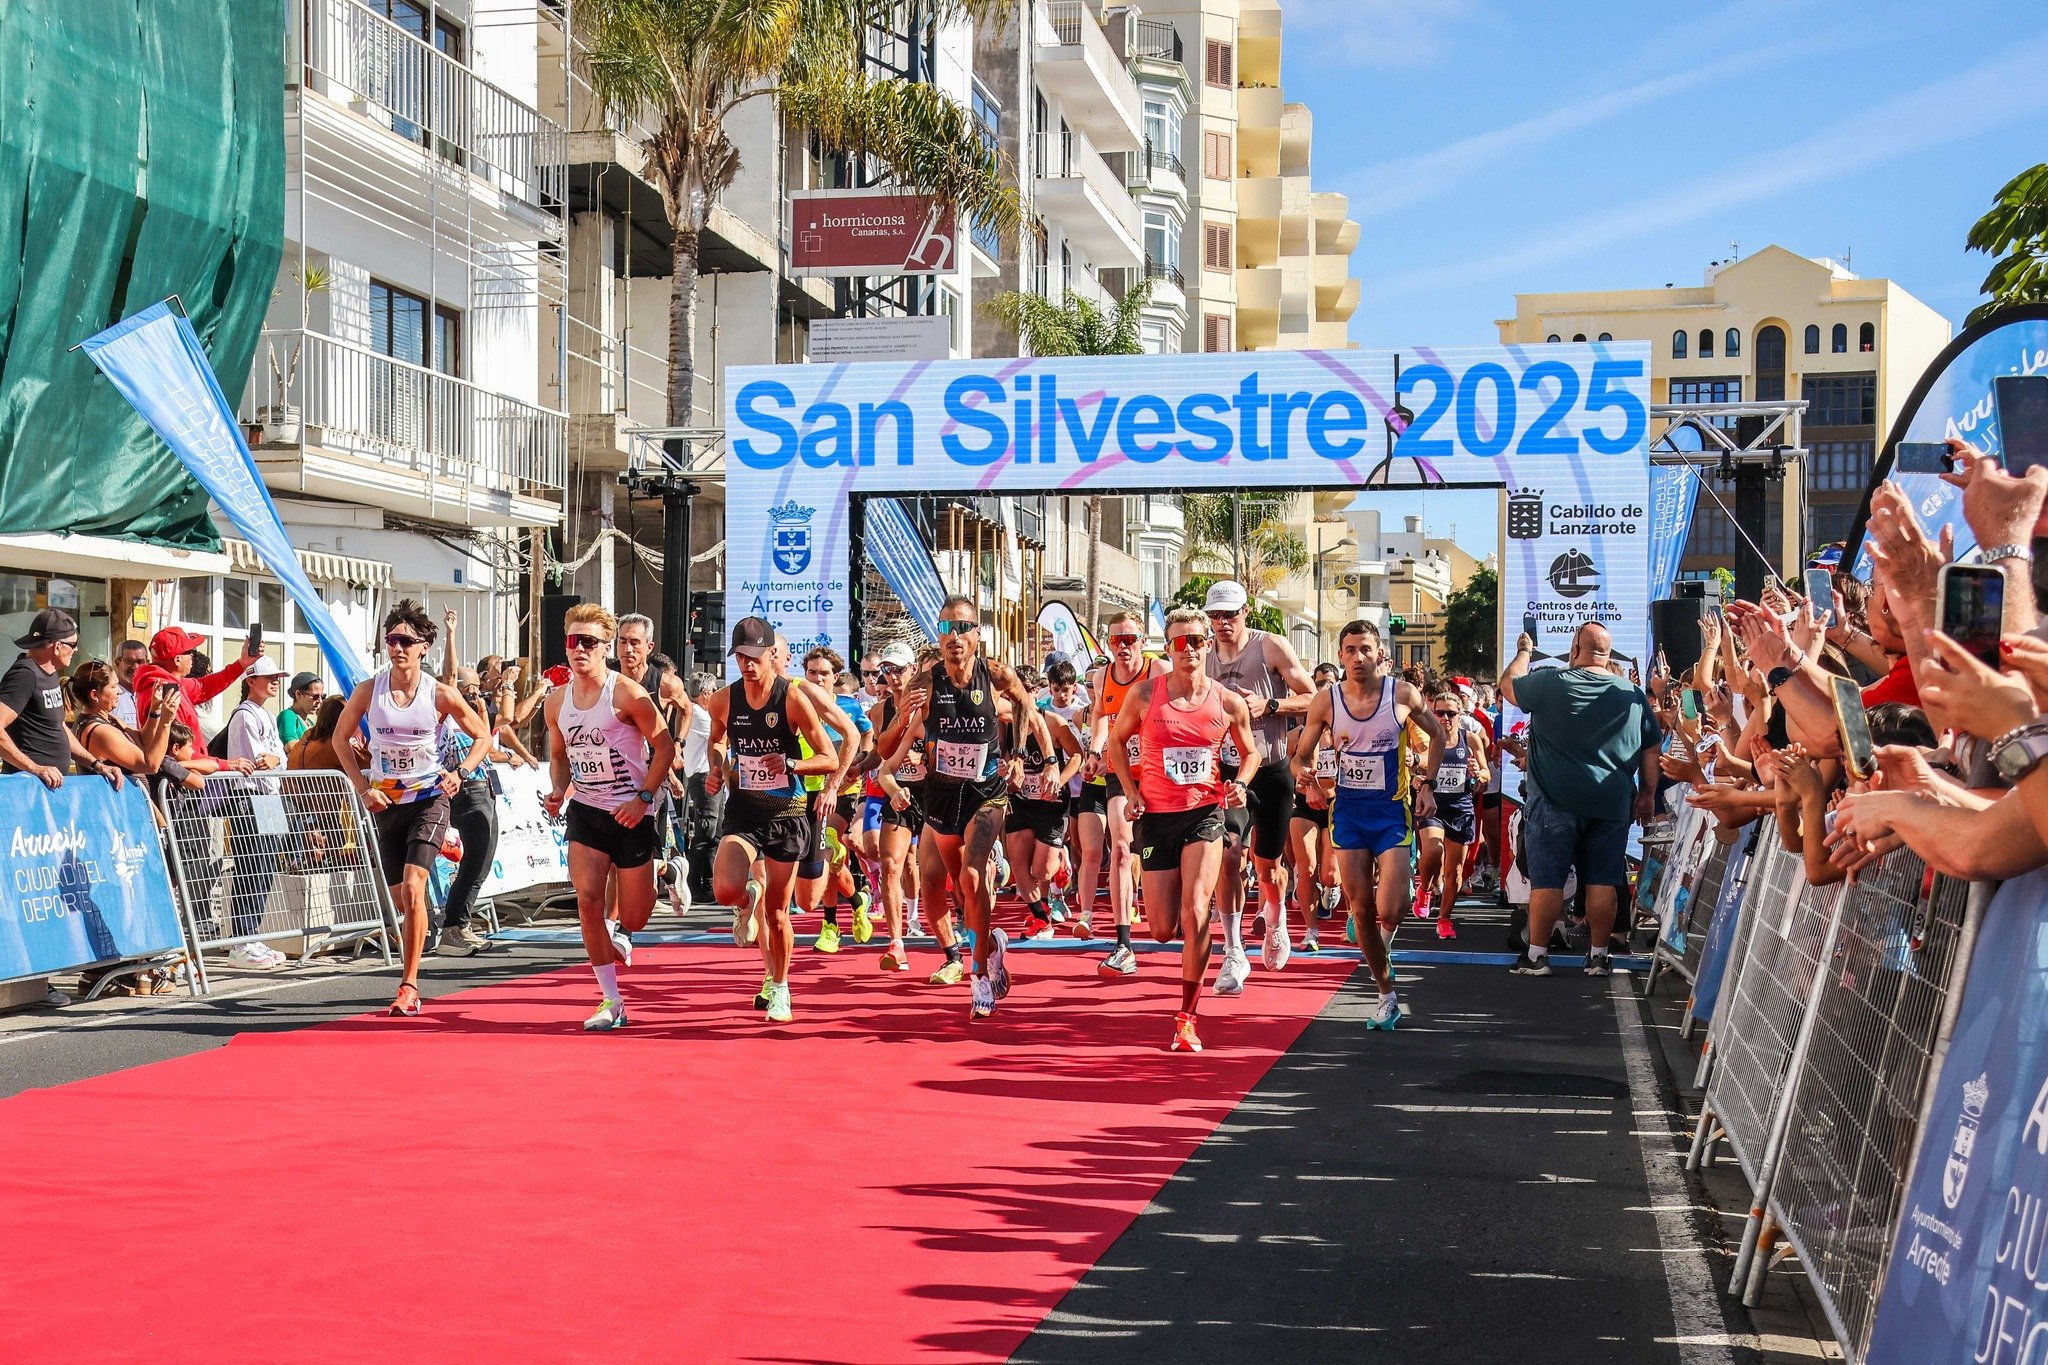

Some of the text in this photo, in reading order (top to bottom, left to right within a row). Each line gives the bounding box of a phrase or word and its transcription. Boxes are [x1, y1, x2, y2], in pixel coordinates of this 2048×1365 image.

[822, 213, 905, 228] hormiconsa
[851, 227, 891, 237] Canarias,
[733, 360, 1646, 470] San Silvestre 2025
[1550, 504, 1643, 518] Cabildo de
[1550, 522, 1636, 535] Lanzarote
[741, 580, 843, 593] Ayuntamiento de
[750, 594, 834, 613] Arrecife
[1527, 601, 1618, 612] Centros de Arte,
[1568, 613, 1573, 623] y
[1577, 611, 1622, 621] Turismo
[1546, 626, 1581, 634] LANZAR
[938, 716, 986, 728] PLAYAS
[737, 737, 780, 750] PLAYAS
[390, 757, 415, 769] 151
[575, 760, 606, 774] 1081
[947, 755, 976, 770] 314
[1171, 760, 1206, 776] 1031
[749, 769, 776, 782] 799
[1346, 768, 1373, 781] 497
[1438, 777, 1458, 787] 748
[10, 819, 87, 858] Arrecife
[15, 860, 107, 893] CIUDAD DEL
[21, 890, 93, 923] DEPORTE
